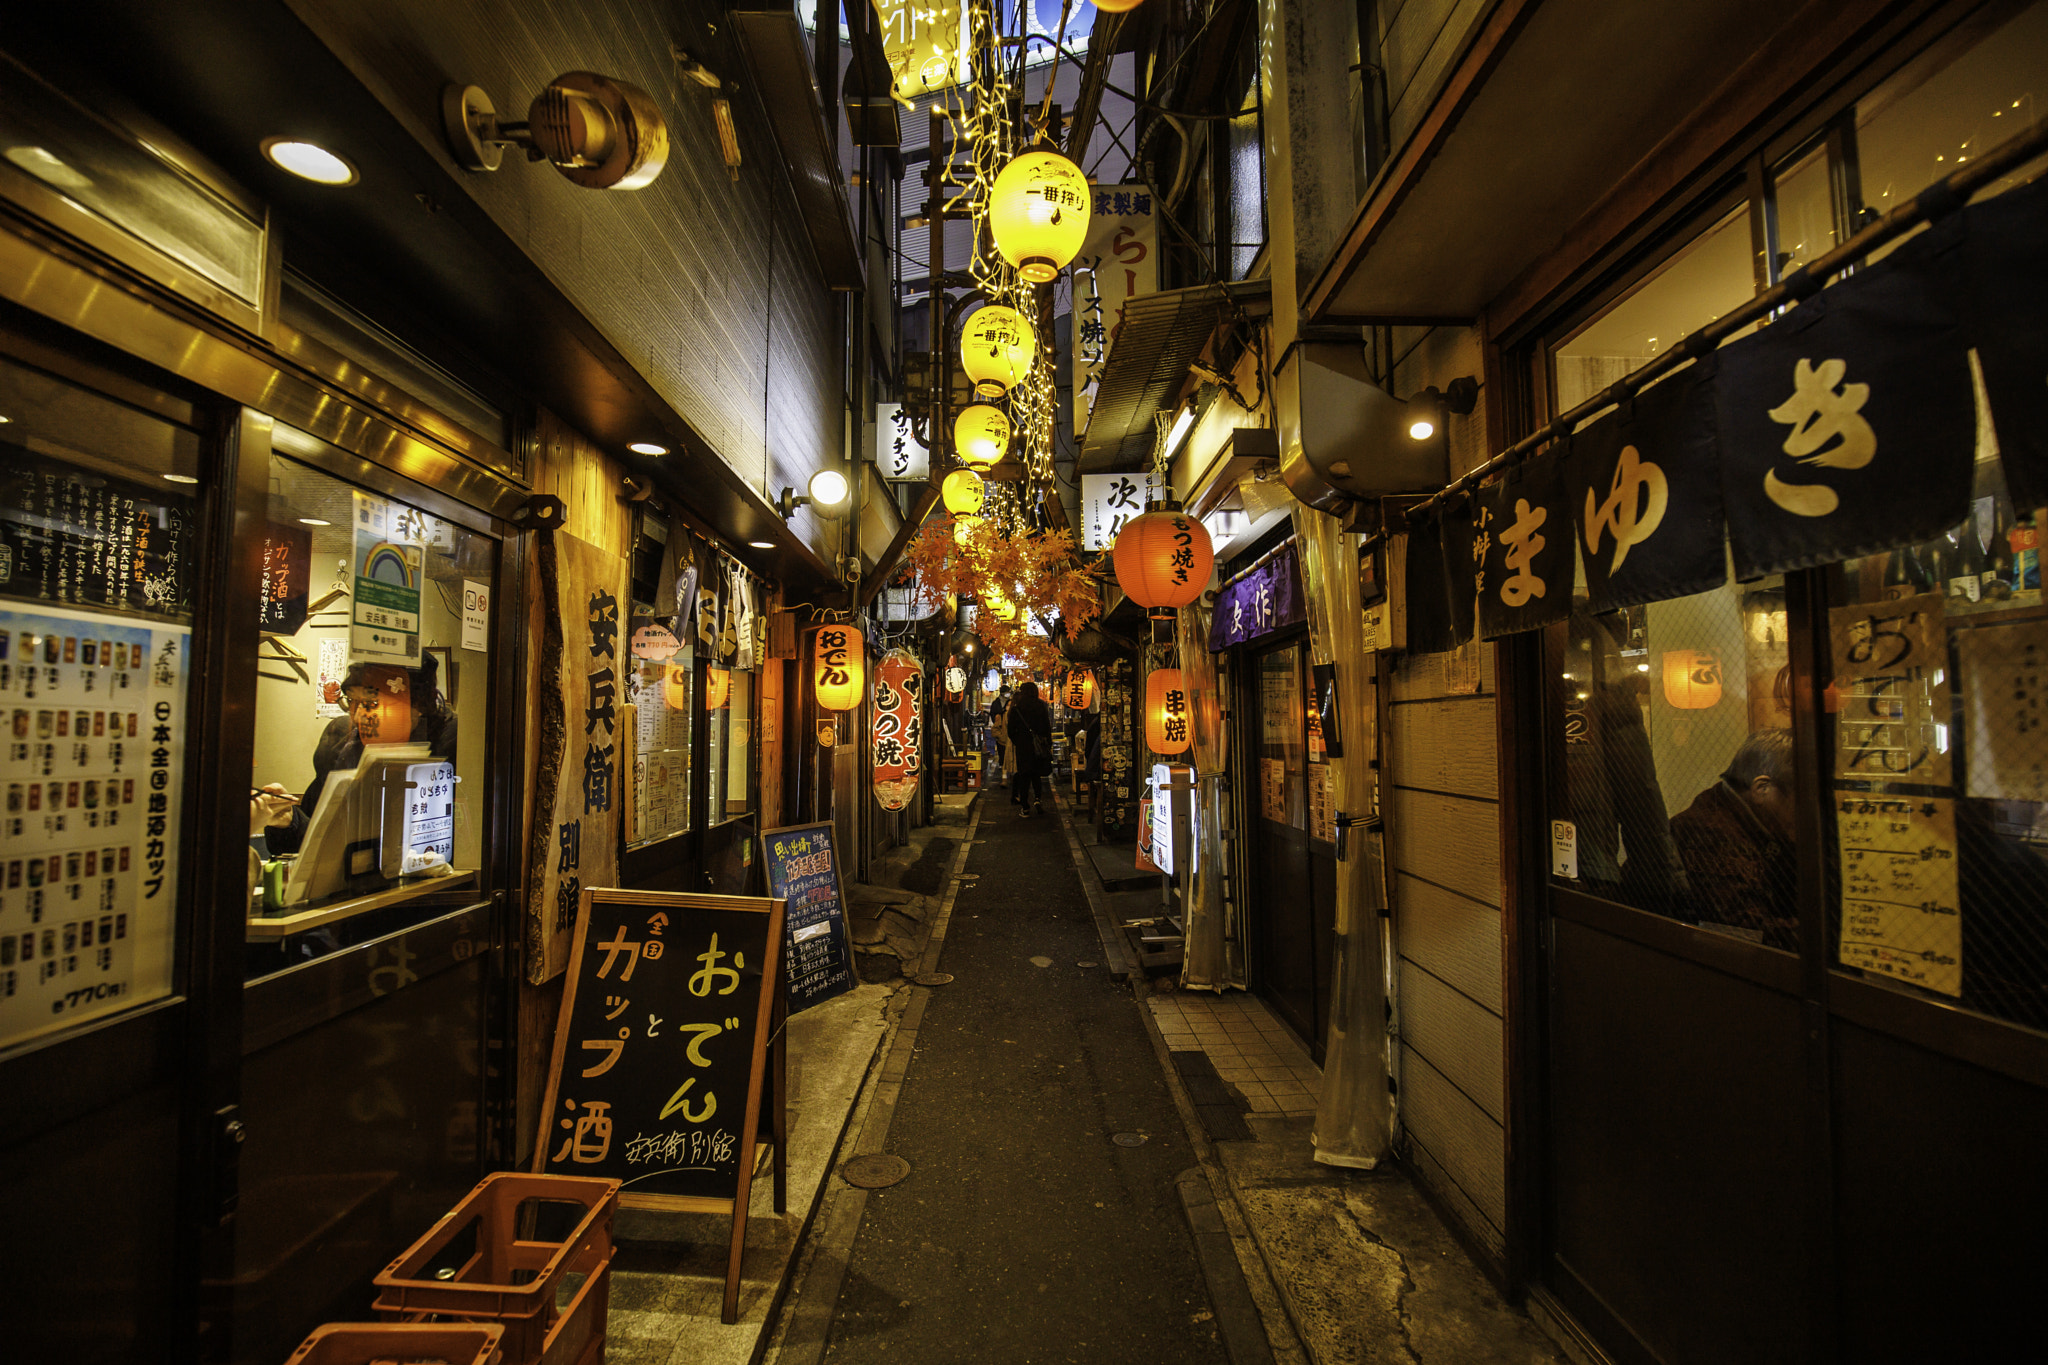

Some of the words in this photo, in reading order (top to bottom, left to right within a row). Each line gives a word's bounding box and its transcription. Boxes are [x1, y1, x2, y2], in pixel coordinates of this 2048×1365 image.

[1026, 185, 1085, 212] 一番搾り
[1170, 515, 1195, 586] もつ焼き
[818, 629, 850, 687] おでん
[582, 588, 618, 816] 安兵衛
[875, 680, 905, 768] もつ焼
[1165, 689, 1188, 743] 串焼
[642, 911, 670, 960] 全国
[552, 925, 642, 1164] カップ酒
[646, 1013, 664, 1038] と
[658, 931, 745, 1124] おでん
